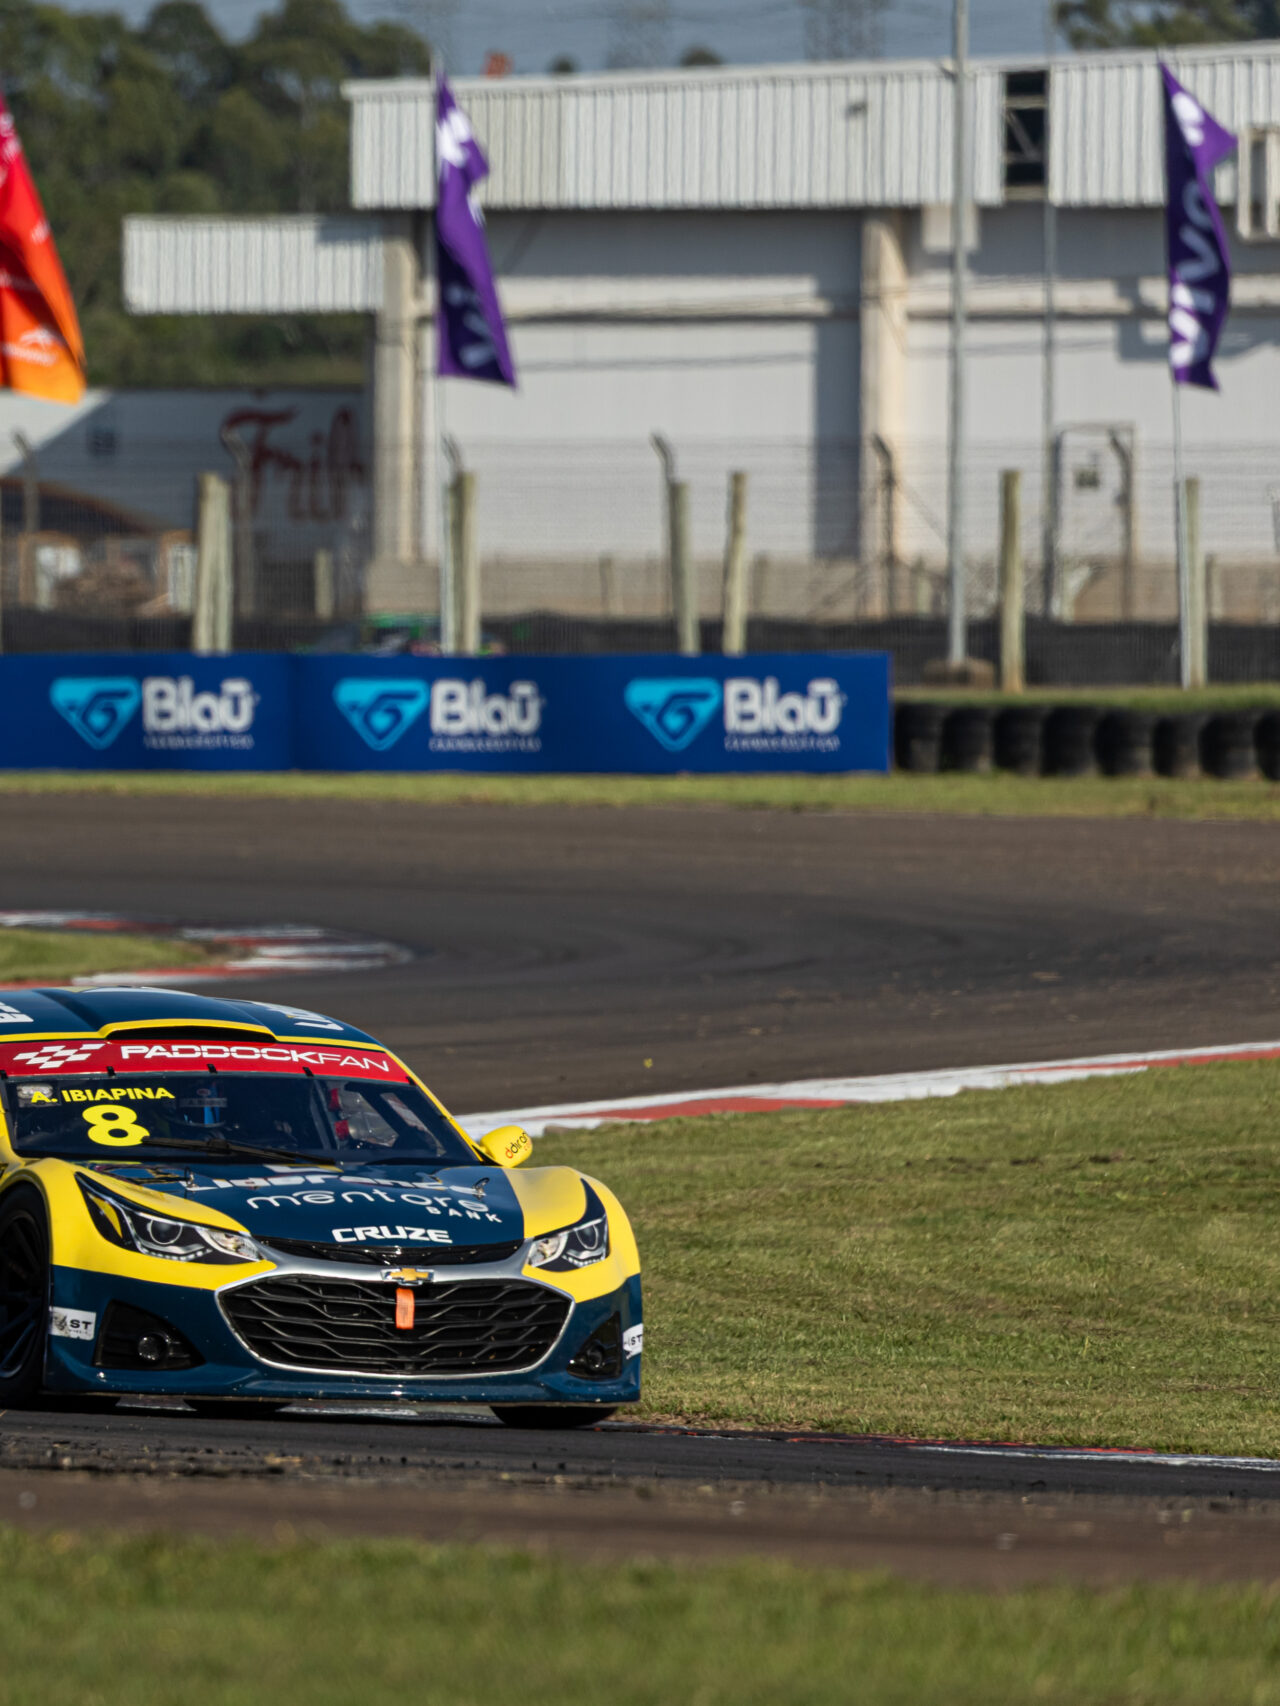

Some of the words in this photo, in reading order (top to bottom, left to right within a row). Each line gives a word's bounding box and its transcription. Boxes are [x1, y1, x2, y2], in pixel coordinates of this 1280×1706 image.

[120, 1044, 390, 1073] PADDOCKFAN
[30, 1091, 58, 1103] A.
[61, 1087, 175, 1102] IBIAPINA
[82, 1104, 150, 1147] 8
[425, 1205, 502, 1223] BANK
[331, 1225, 453, 1244] CRUZE
